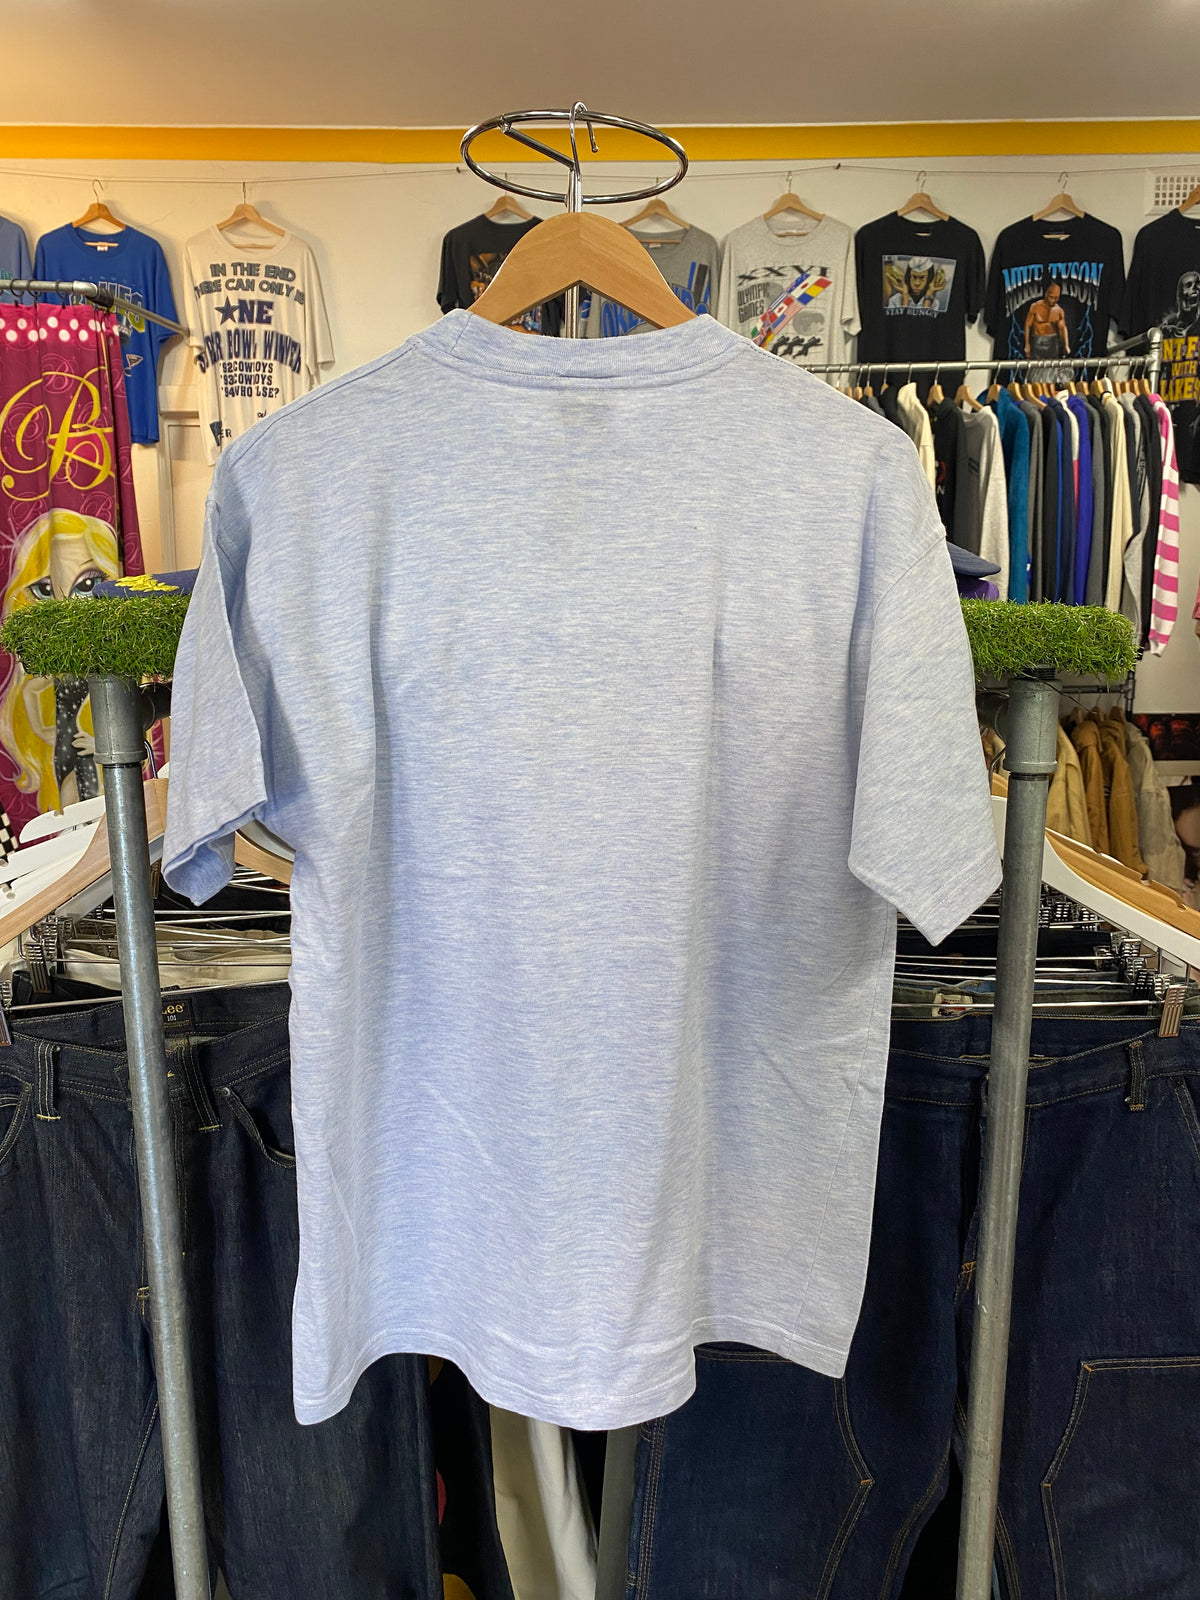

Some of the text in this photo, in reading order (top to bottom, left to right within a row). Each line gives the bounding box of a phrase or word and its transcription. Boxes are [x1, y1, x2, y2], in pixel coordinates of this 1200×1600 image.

[210, 262, 296, 282] IN THE END
[1002, 261, 1104, 293] MIKE TYSON
[225, 278, 255, 291] CAN
[259, 280, 295, 297] ONLY
[1171, 361, 1197, 377] WITH
